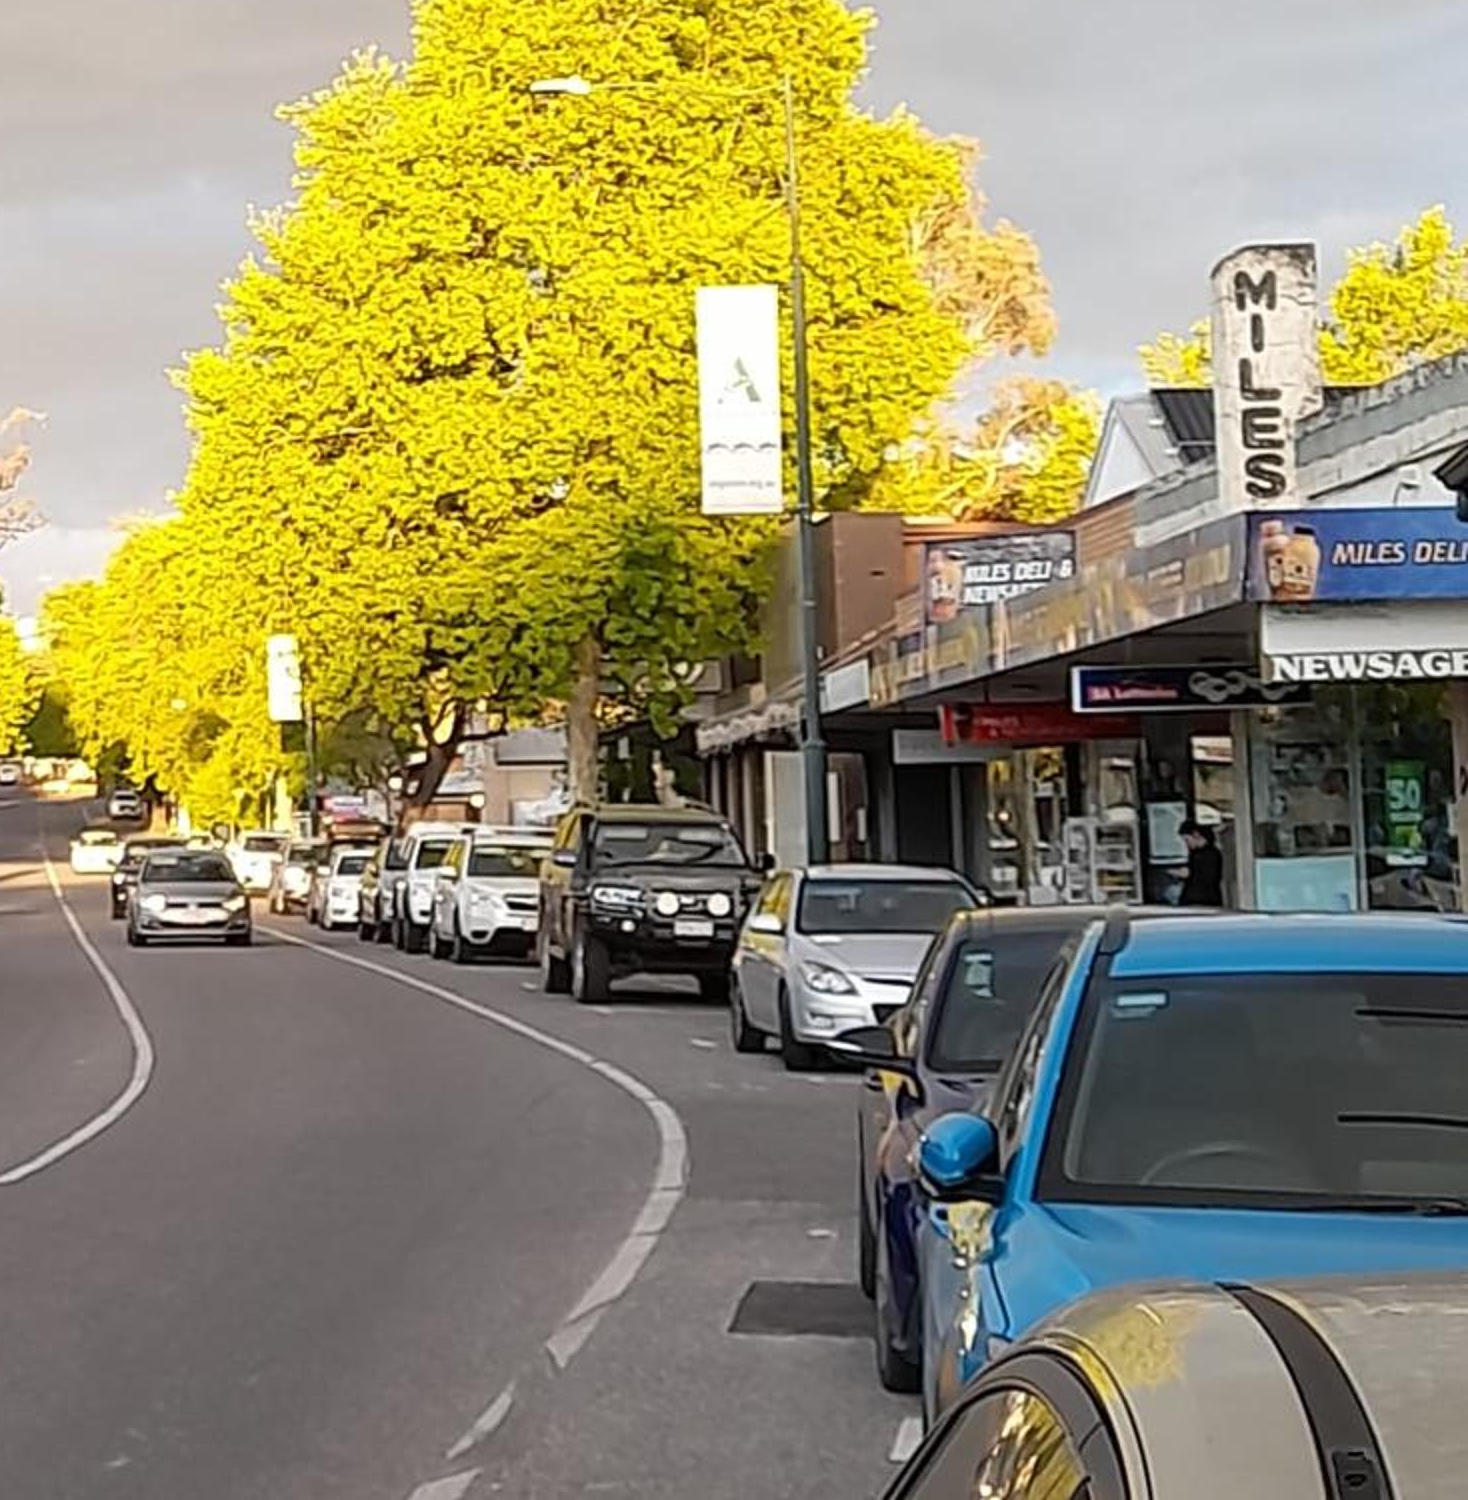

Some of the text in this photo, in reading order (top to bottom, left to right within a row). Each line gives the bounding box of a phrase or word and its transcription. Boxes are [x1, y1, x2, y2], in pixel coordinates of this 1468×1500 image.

[1234, 270, 1287, 498] MILES
[1333, 540, 1468, 565] MILES DELI
[1013, 560, 1053, 581] DELI
